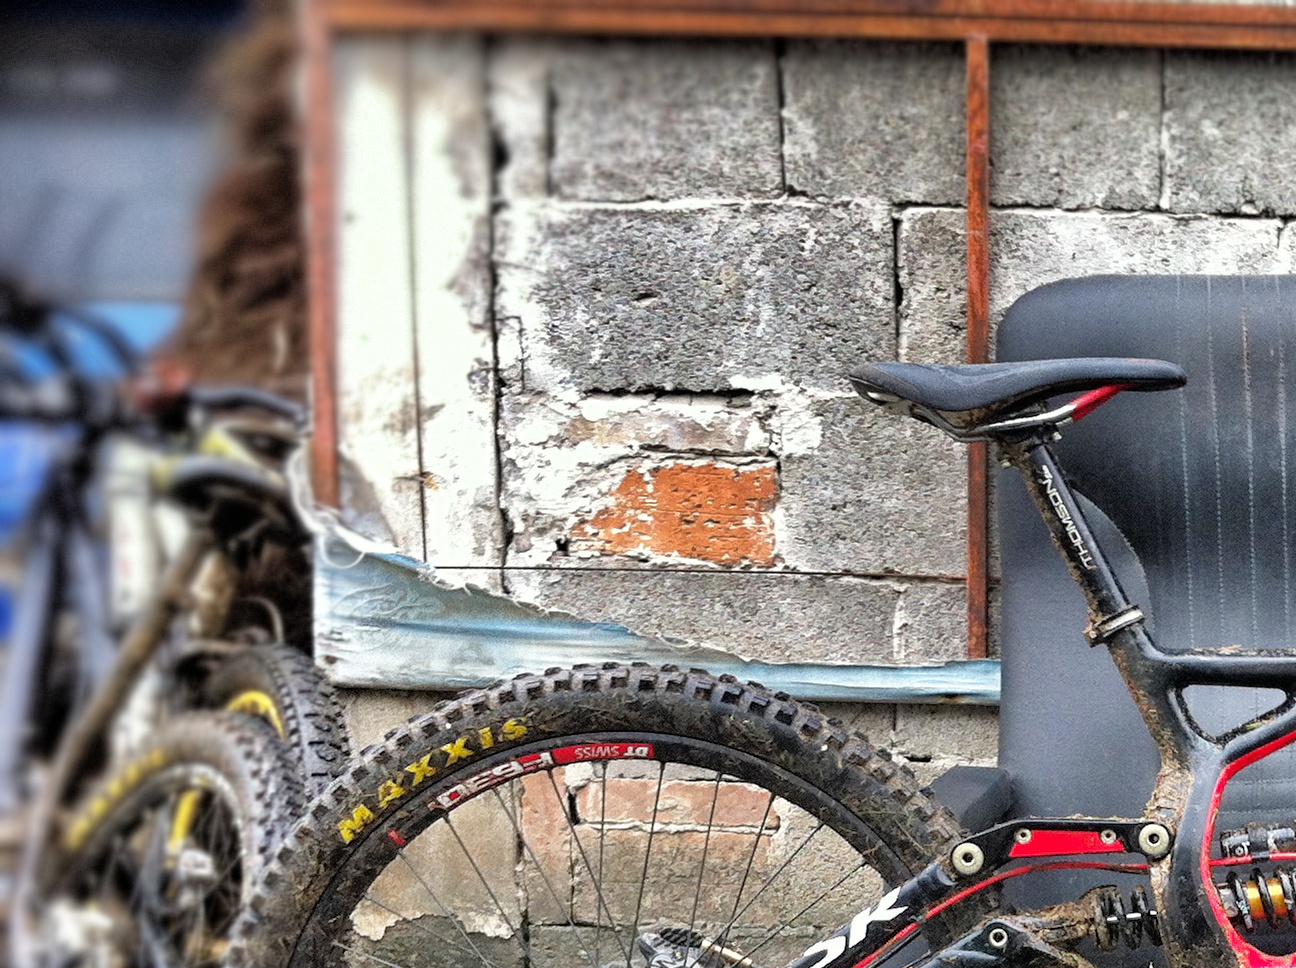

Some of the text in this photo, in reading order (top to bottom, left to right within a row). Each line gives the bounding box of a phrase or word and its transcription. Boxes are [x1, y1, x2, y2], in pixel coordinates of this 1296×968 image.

[1042, 479, 1093, 570] THOMSON
[573, 745, 619, 759] SWISS
[623, 746, 648, 757] DT
[337, 717, 527, 844] MAXXIS
